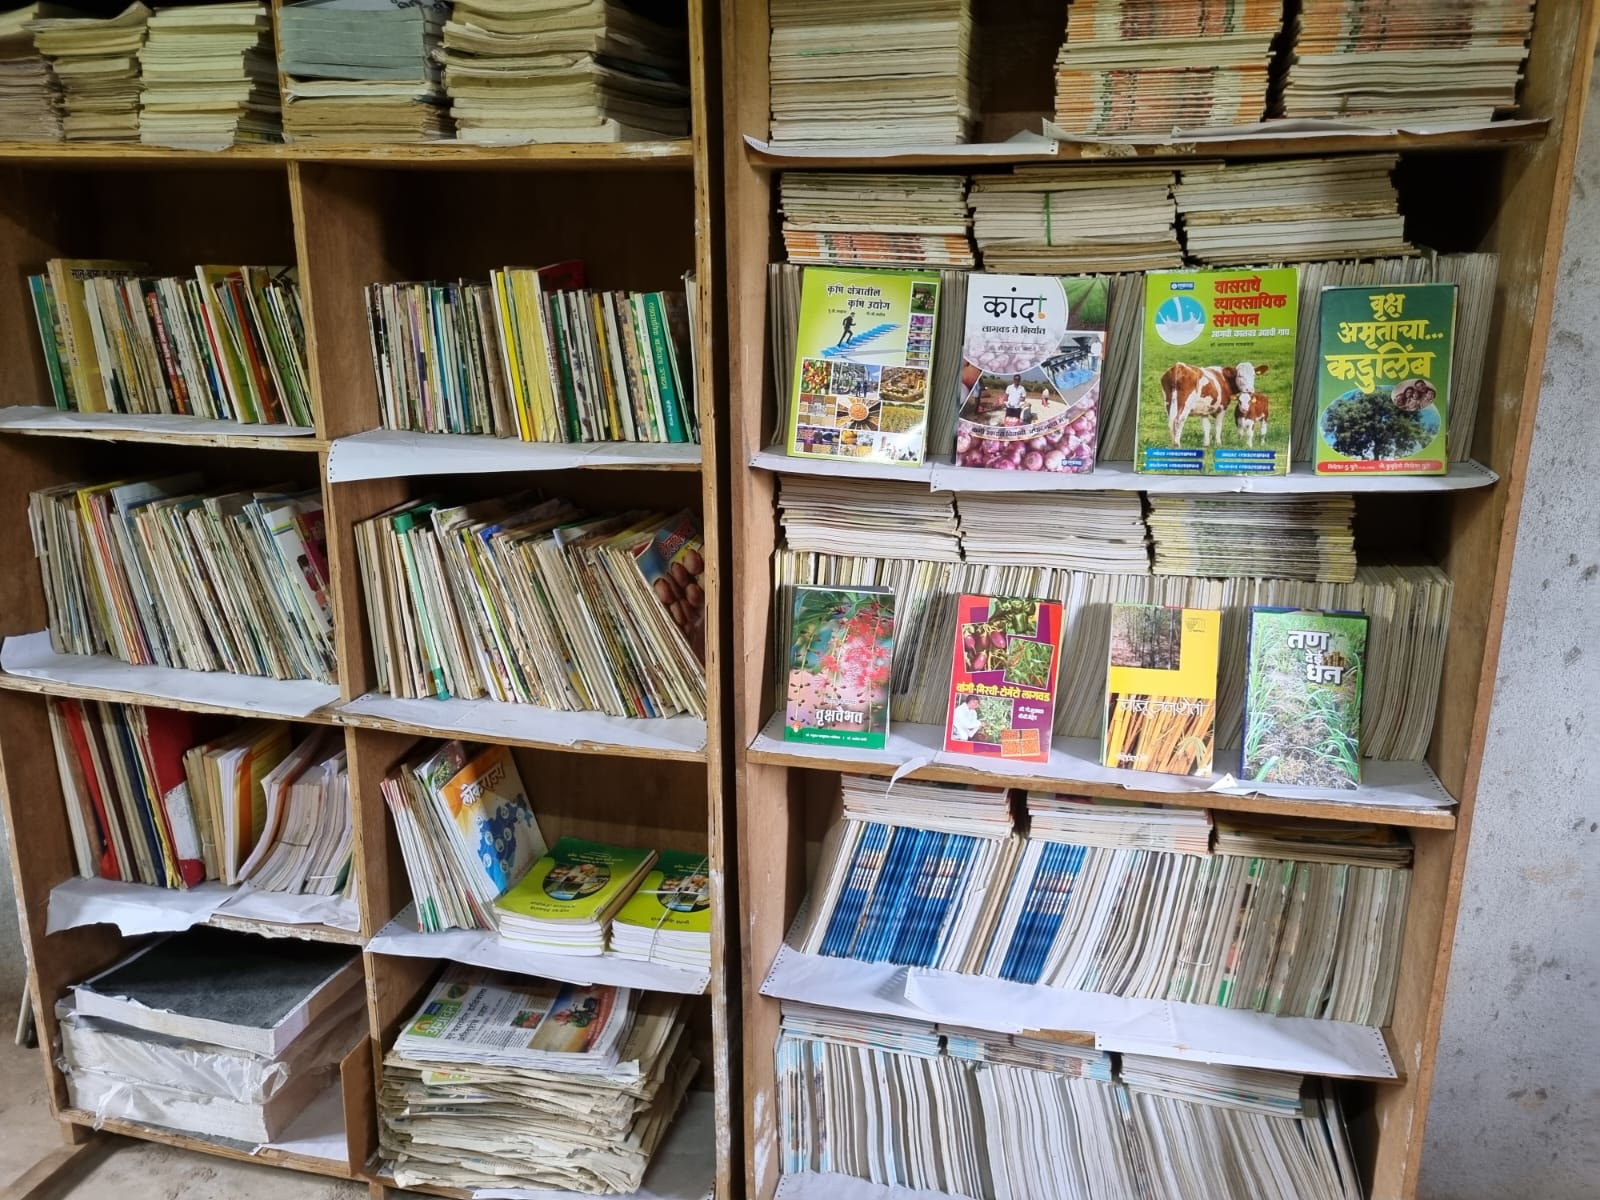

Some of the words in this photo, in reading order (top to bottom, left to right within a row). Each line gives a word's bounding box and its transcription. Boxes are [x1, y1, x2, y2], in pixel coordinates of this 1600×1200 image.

[1214, 275, 1262, 293] वासराचे
[867, 299, 891, 311] उद्योग
[982, 286, 1047, 323] कांदा
[1213, 292, 1287, 310] व्यावसायिक
[1368, 292, 1406, 322] वृक्ष
[1212, 310, 1260, 328] संगोपन
[982, 325, 1010, 334] लागवड
[1011, 324, 1019, 334] ते
[1020, 325, 1046, 336] निर्यात
[1324, 341, 1436, 394] कडुलिंब
[1287, 630, 1330, 650] तण
[1306, 663, 1345, 685] धन
[1021, 690, 1051, 702] लागवड
[459, 765, 507, 808] लोकराज्य
